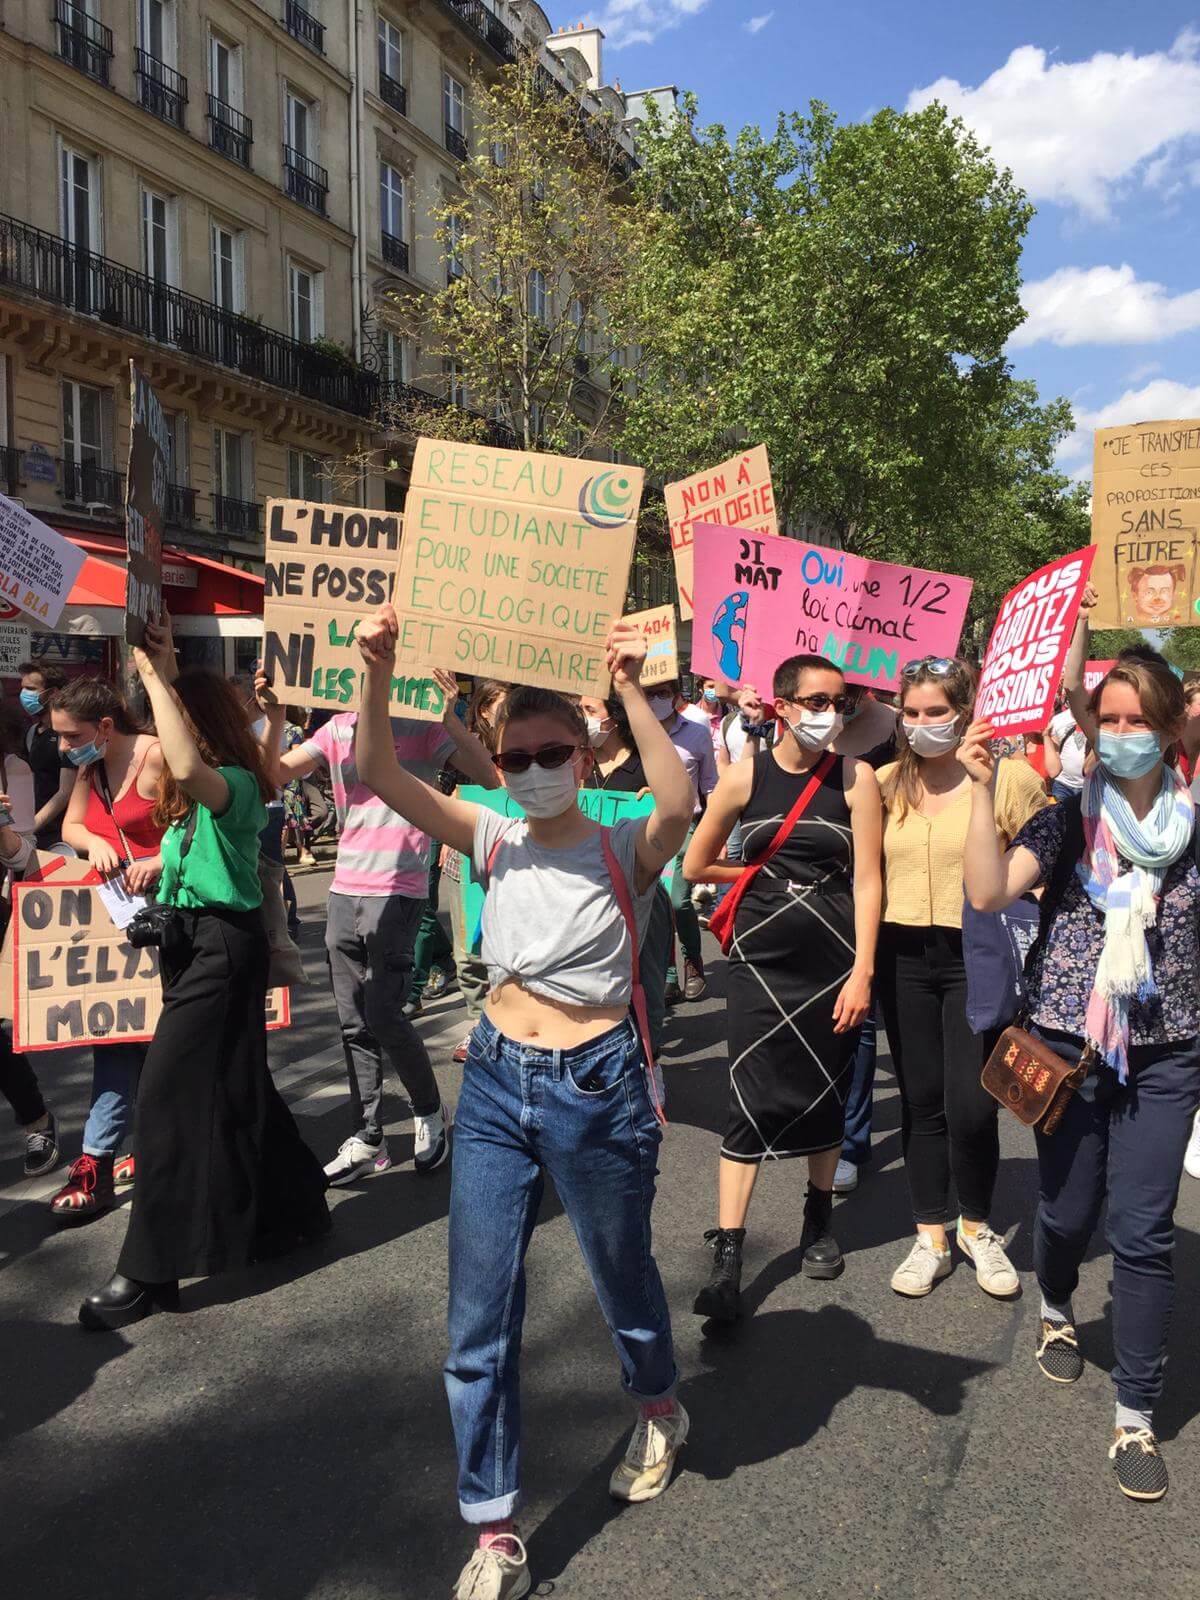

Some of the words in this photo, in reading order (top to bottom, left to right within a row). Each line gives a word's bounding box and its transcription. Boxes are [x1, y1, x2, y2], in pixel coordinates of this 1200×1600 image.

[681, 474, 726, 508] NON
[737, 457, 751, 485] À
[1140, 463, 1172, 477] CES
[270, 505, 403, 550] L'HOM
[669, 483, 773, 550] L'ÉOLOGIE
[1121, 508, 1183, 533] SANS
[17, 545, 33, 559] SANS
[51, 568, 63, 580] SOIT
[31, 536, 39, 545] DE
[40, 543, 56, 557] CETTE
[416, 537, 471, 573] POUR
[484, 552, 520, 578] UNE
[528, 560, 609, 596] SOCIÉTÉ
[26, 570, 61, 597] APPLICATION
[264, 562, 305, 597] NE
[735, 563, 782, 591] MAT
[853, 580, 880, 597] une
[900, 575, 950, 614] 1/2
[1002, 560, 1083, 621] VOUS
[23, 590, 49, 618] BLA
[802, 588, 829, 622] loi
[643, 615, 671, 634] 404
[986, 586, 1077, 664] SABOTEZ
[0, 646, 21, 655] ERVICE
[264, 623, 315, 688] NI
[401, 619, 444, 654] ET
[455, 628, 600, 681] SOLIDAIRE
[821, 632, 899, 681] AUCUN
[981, 634, 1061, 687] NOUS
[312, 666, 356, 704] LES
[22, 888, 92, 930] ON
[27, 930, 161, 991] L'ÉLYS
[46, 997, 146, 1042] MON
